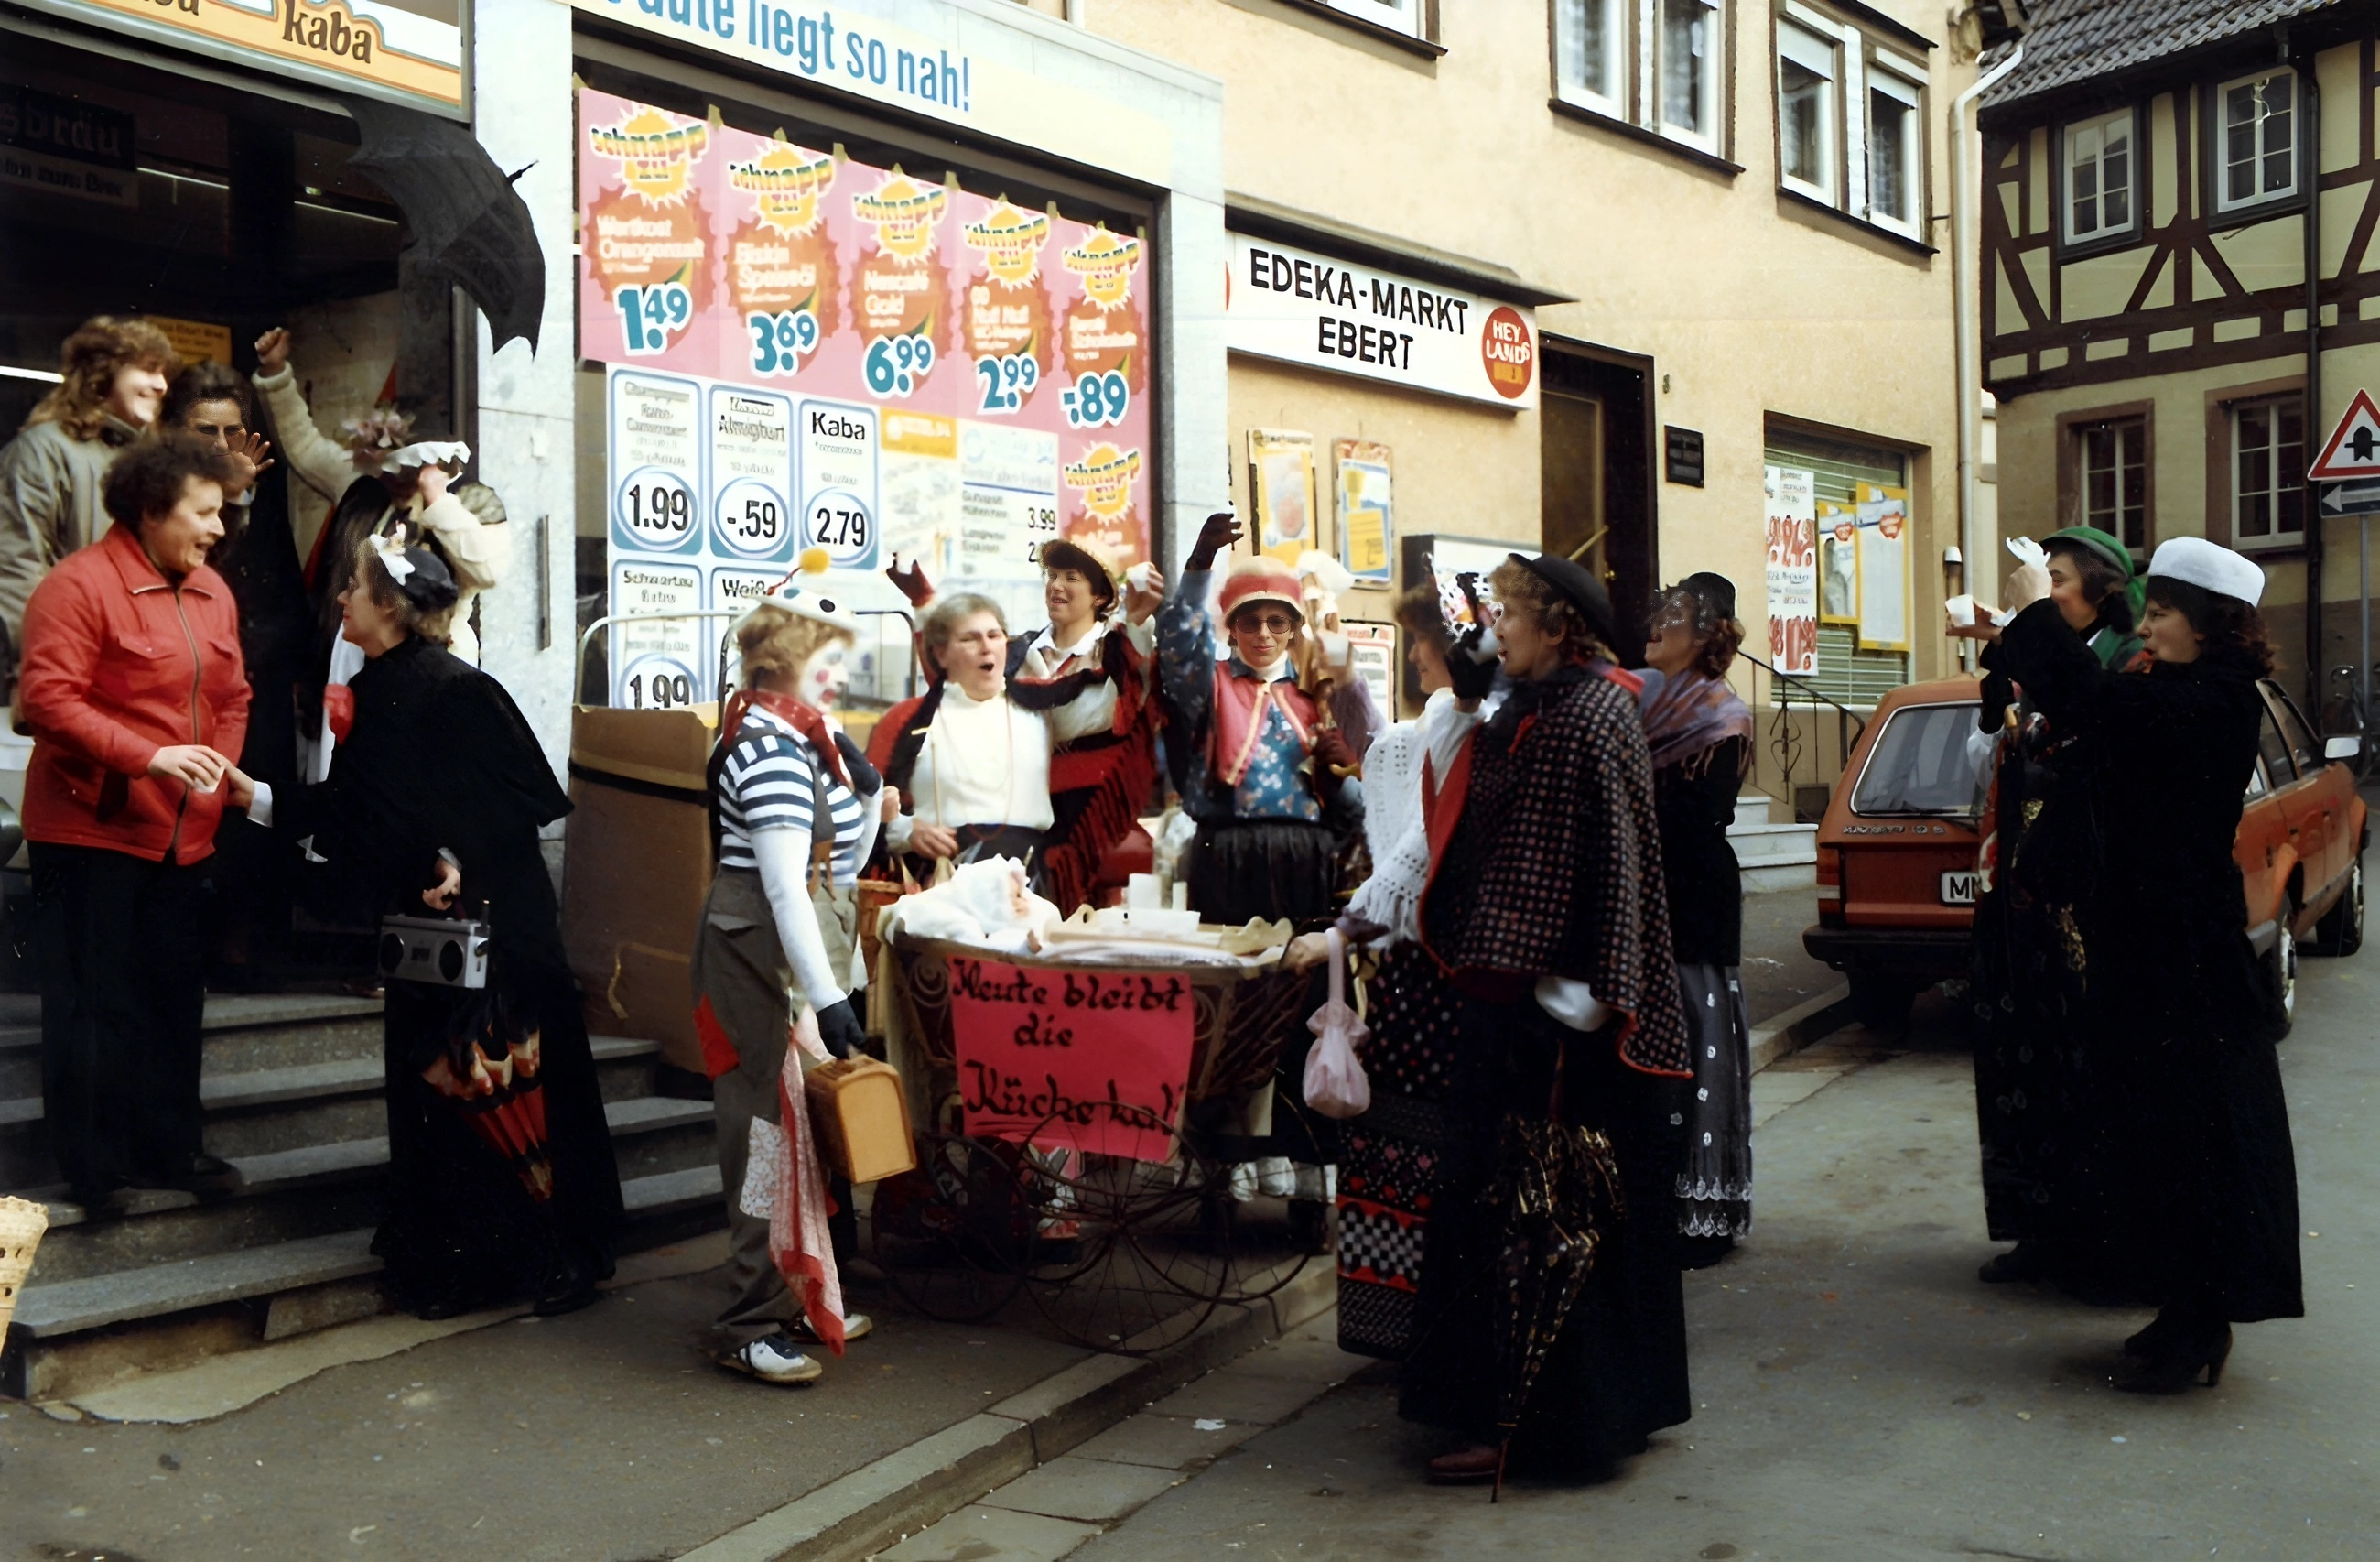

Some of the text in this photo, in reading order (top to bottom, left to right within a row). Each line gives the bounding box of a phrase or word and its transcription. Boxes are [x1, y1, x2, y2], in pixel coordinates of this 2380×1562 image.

[281, 0, 372, 64] kaba
[638, 0, 969, 112] ute liegt so nah!
[1250, 247, 1468, 335] EDEKA-MARKT
[618, 288, 687, 350] 1.49
[750, 314, 816, 371] 3.69
[1318, 316, 1414, 370] EBERT
[866, 339, 932, 393] 6.99
[979, 358, 1036, 409] 2.99
[811, 411, 866, 440] Kaba
[628, 484, 688, 531] 1.99
[727, 499, 776, 538] -.59
[817, 507, 866, 548] 2.79
[1028, 507, 1055, 530] 3.99
[952, 958, 1185, 1012] Heute bleibt
[1013, 1012, 1074, 1047] die
